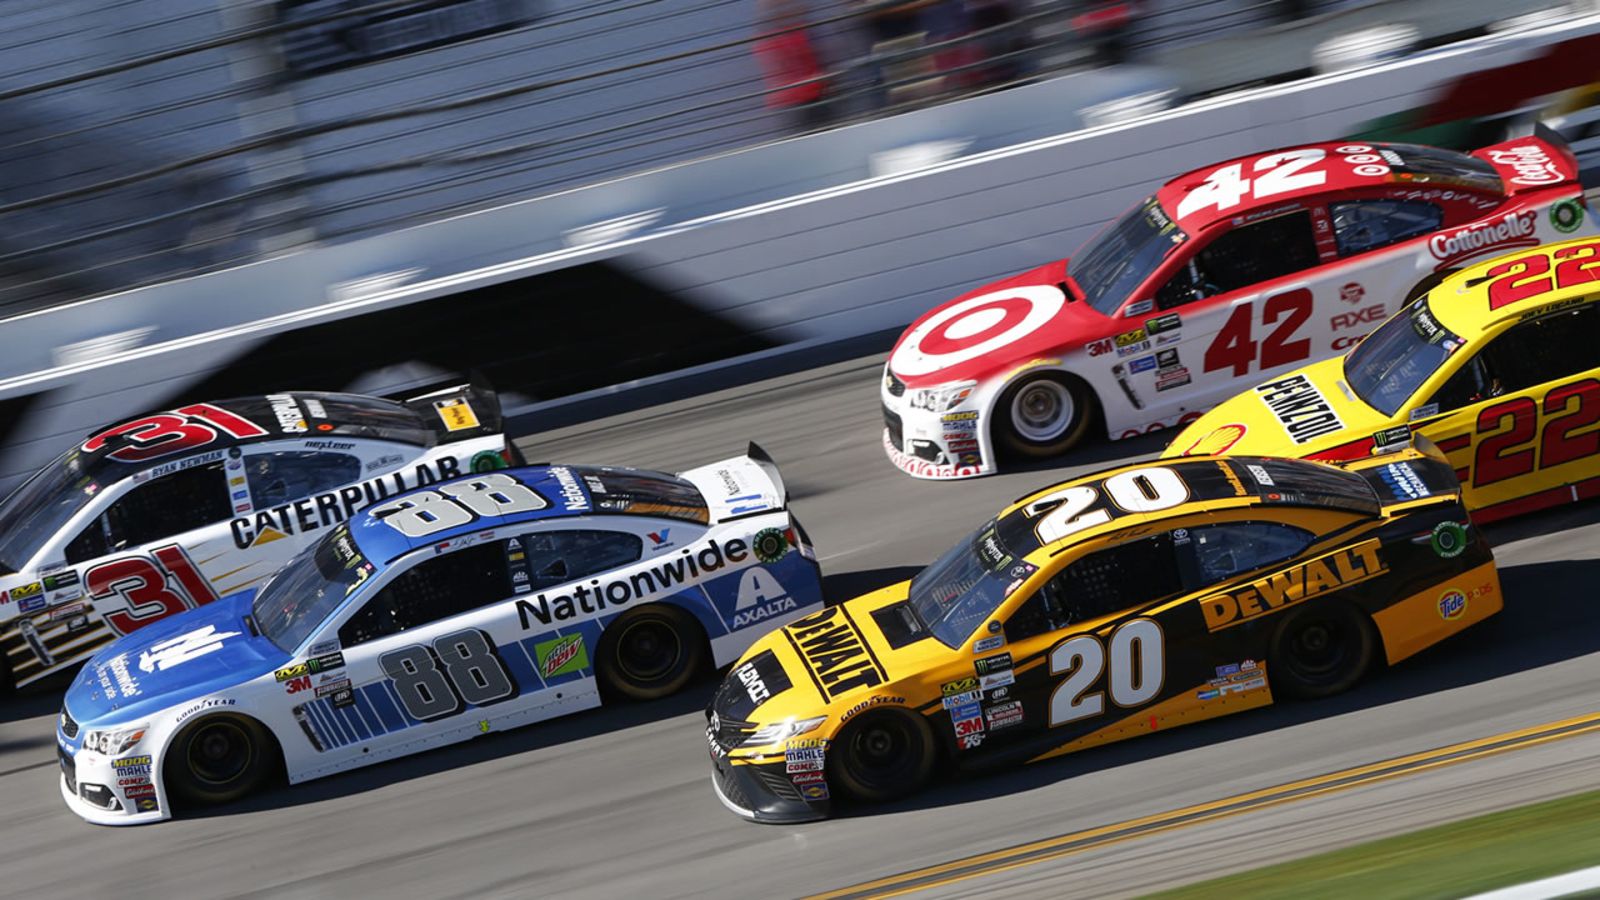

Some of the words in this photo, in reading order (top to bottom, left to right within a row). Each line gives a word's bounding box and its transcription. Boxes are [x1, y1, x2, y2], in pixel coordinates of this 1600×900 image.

[1176, 149, 1327, 221] 42
[1431, 212, 1534, 258] Cottonelle
[1487, 242, 1600, 311] 22
[1204, 287, 1313, 377] 42
[1331, 303, 1387, 331] AXE
[1088, 339, 1113, 357] 3M
[1256, 375, 1345, 445] PENNZOIL
[81, 403, 270, 463] 31
[305, 441, 356, 450] nexteer
[1472, 378, 1600, 489] 22
[152, 461, 178, 479] RYAN
[179, 451, 224, 471] NEWMAN
[230, 455, 462, 550] CATERPILLAR
[368, 473, 554, 537] 88
[547, 466, 591, 511] Nationwide
[1022, 467, 1190, 546] 20
[83, 543, 221, 637] 31
[515, 538, 748, 631] Nationwide
[1440, 595, 1464, 618] Tide
[733, 597, 797, 630] AXALTA
[110, 653, 138, 697] Nationwide
[285, 675, 312, 694] 3M
[378, 626, 519, 722] 88
[1049, 617, 1165, 728] 20
[945, 693, 971, 707] Mobil
[787, 738, 826, 749] MOOG
[956, 717, 983, 735] 3M
[114, 756, 151, 767] MOOG
[116, 766, 153, 776] MAHLE
[786, 750, 824, 761] MAHLE
